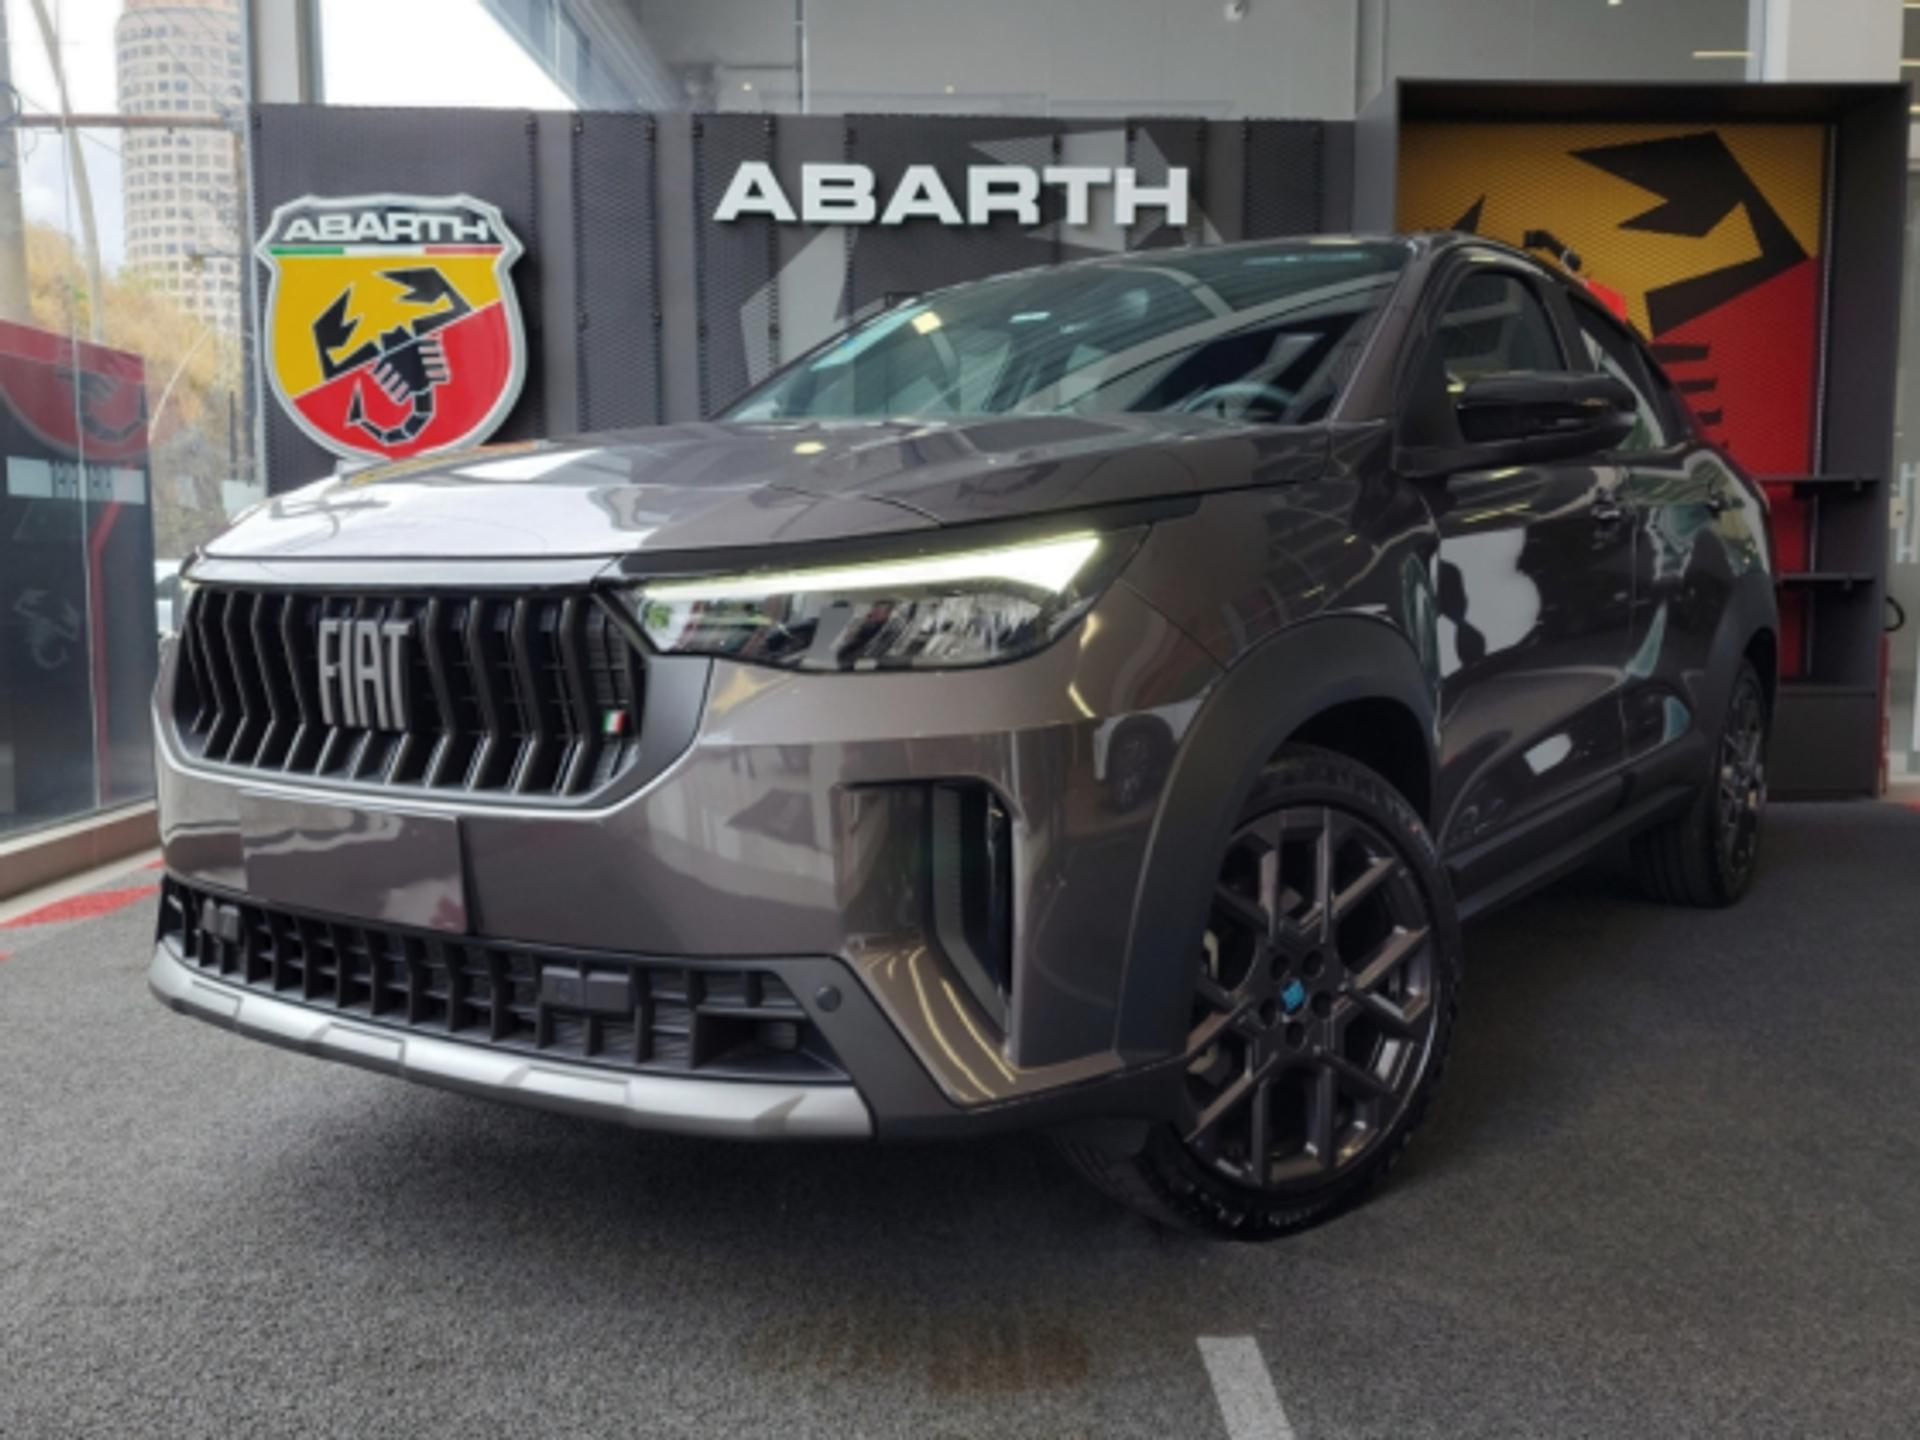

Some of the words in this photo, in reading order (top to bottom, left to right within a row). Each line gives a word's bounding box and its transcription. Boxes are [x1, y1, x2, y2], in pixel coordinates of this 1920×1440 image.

[713, 161, 1189, 225] ABARTH
[282, 212, 490, 242] ABARTH
[319, 620, 410, 731] FIAT
